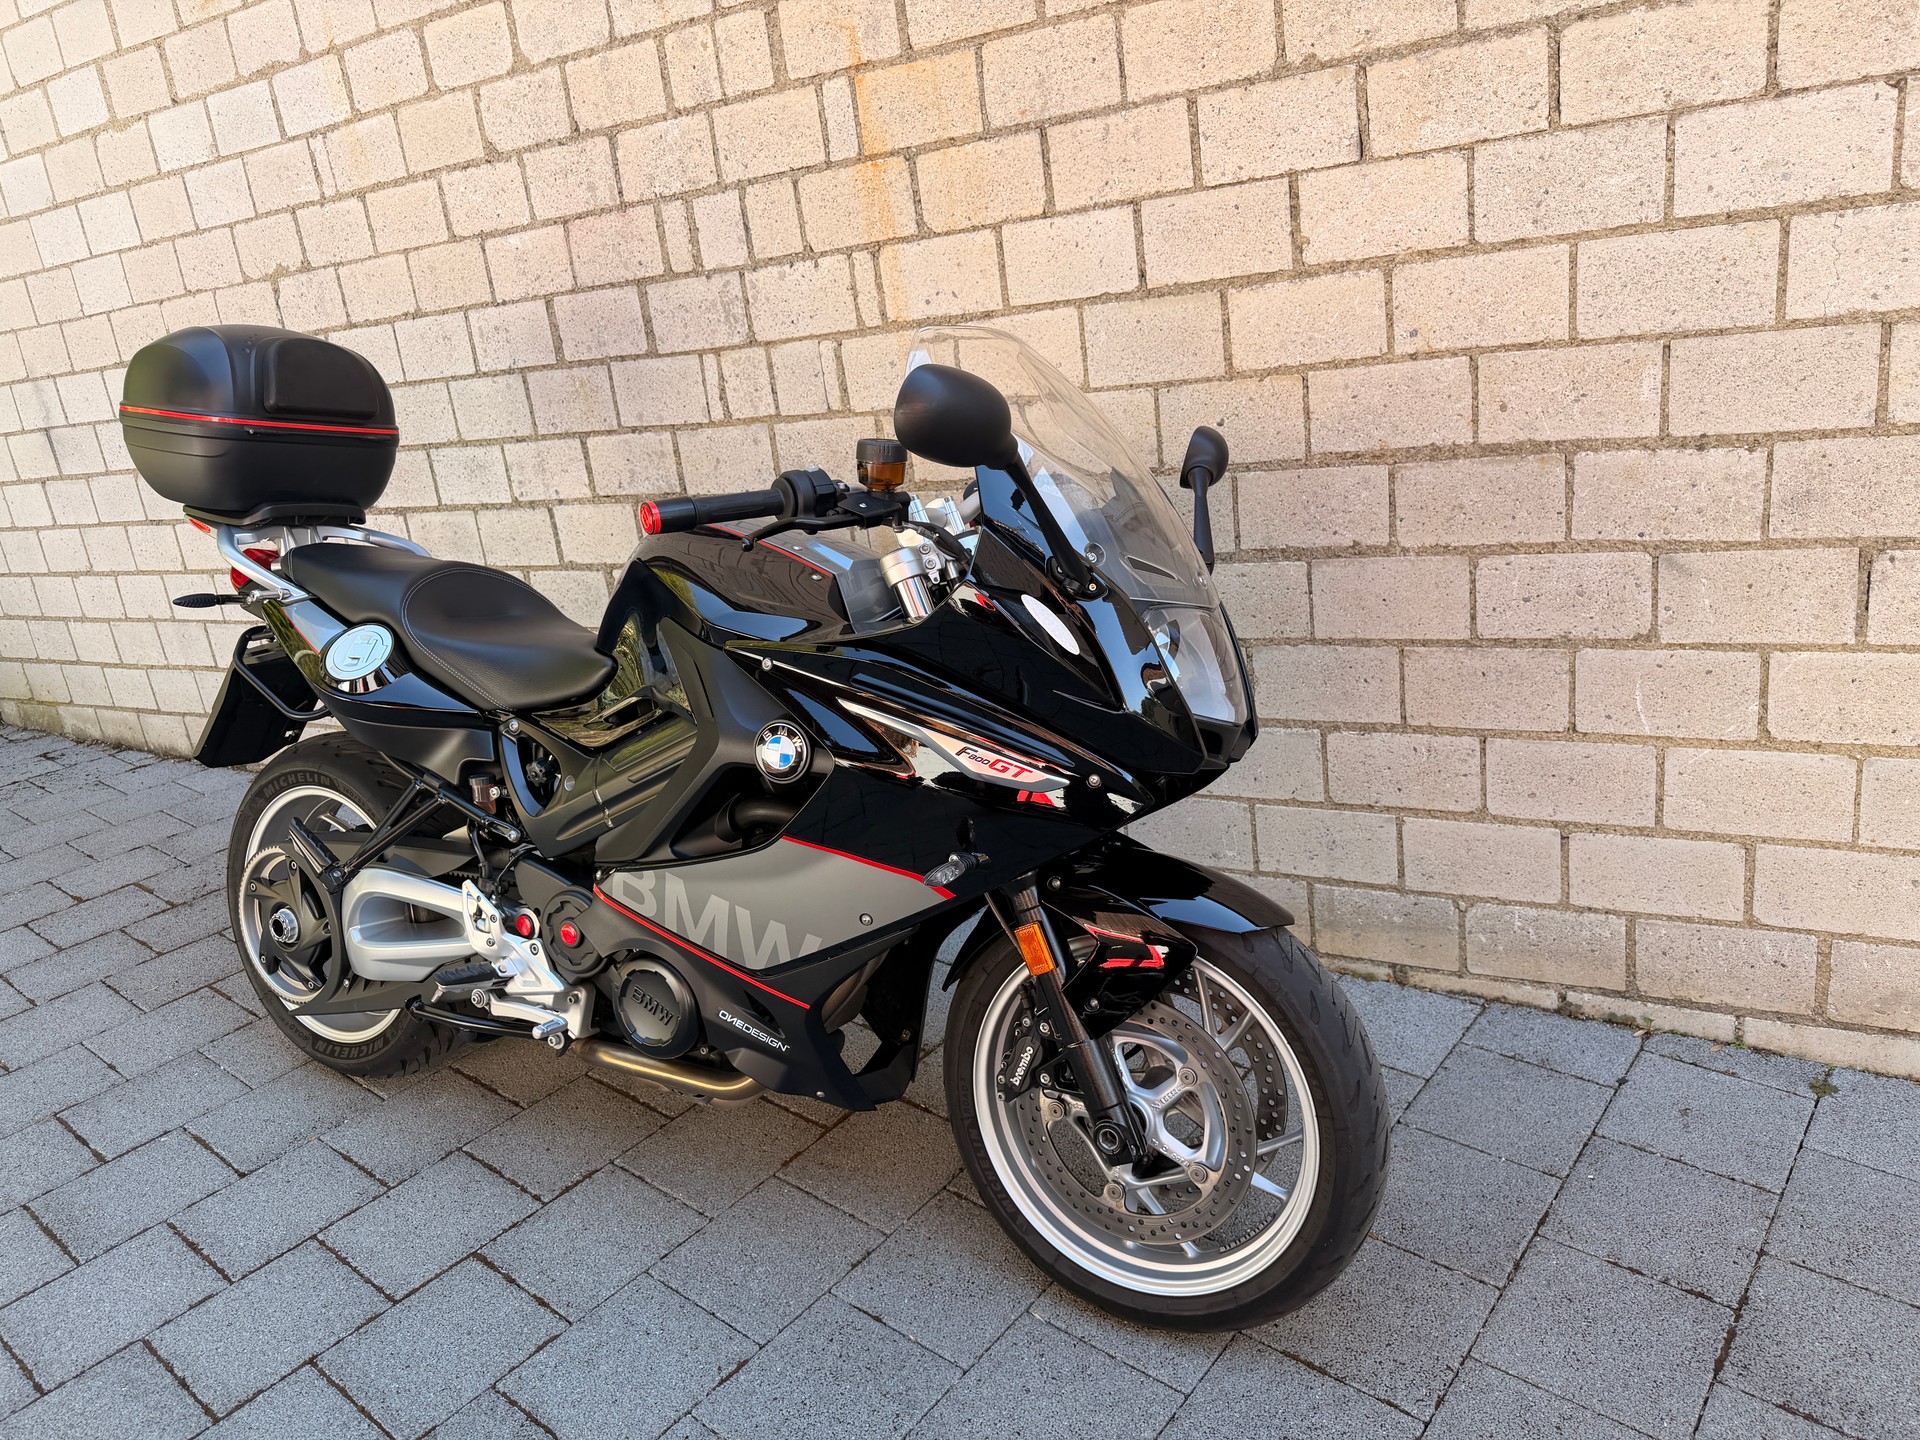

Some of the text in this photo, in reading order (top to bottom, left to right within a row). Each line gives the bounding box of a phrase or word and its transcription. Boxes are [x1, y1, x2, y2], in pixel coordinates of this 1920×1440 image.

[762, 726, 803, 752] BMW
[263, 772, 331, 799] MICHELIN
[612, 870, 823, 970] BMW
[632, 985, 675, 1026] BMW
[315, 1036, 384, 1058] MICHELIN
[1010, 1046, 1034, 1086] brembo
